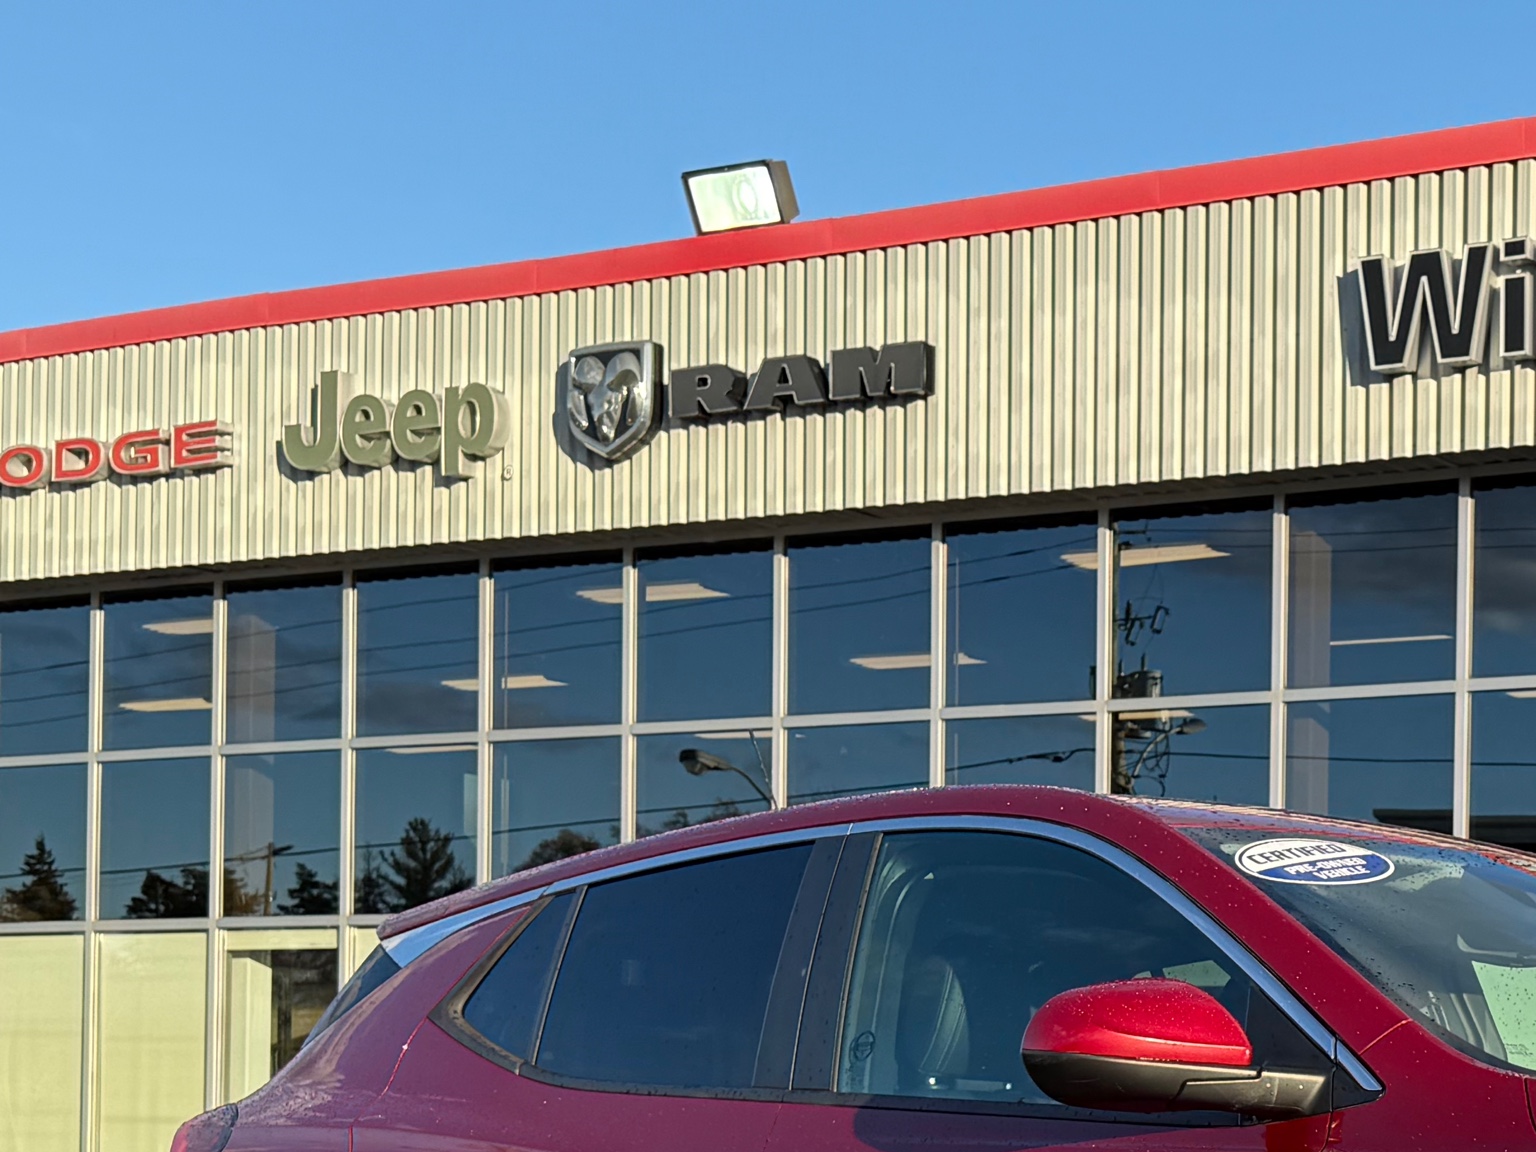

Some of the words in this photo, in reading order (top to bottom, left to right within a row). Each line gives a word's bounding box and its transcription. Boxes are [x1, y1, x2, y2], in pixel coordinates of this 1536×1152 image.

[670, 340, 934, 418] RAM
[281, 370, 506, 479] Jeep
[0, 420, 231, 489] ODGE
[1246, 843, 1347, 865] CERTIFIED
[1284, 857, 1367, 875] PRE-OWNED
[1312, 866, 1371, 880] VEHICLE
